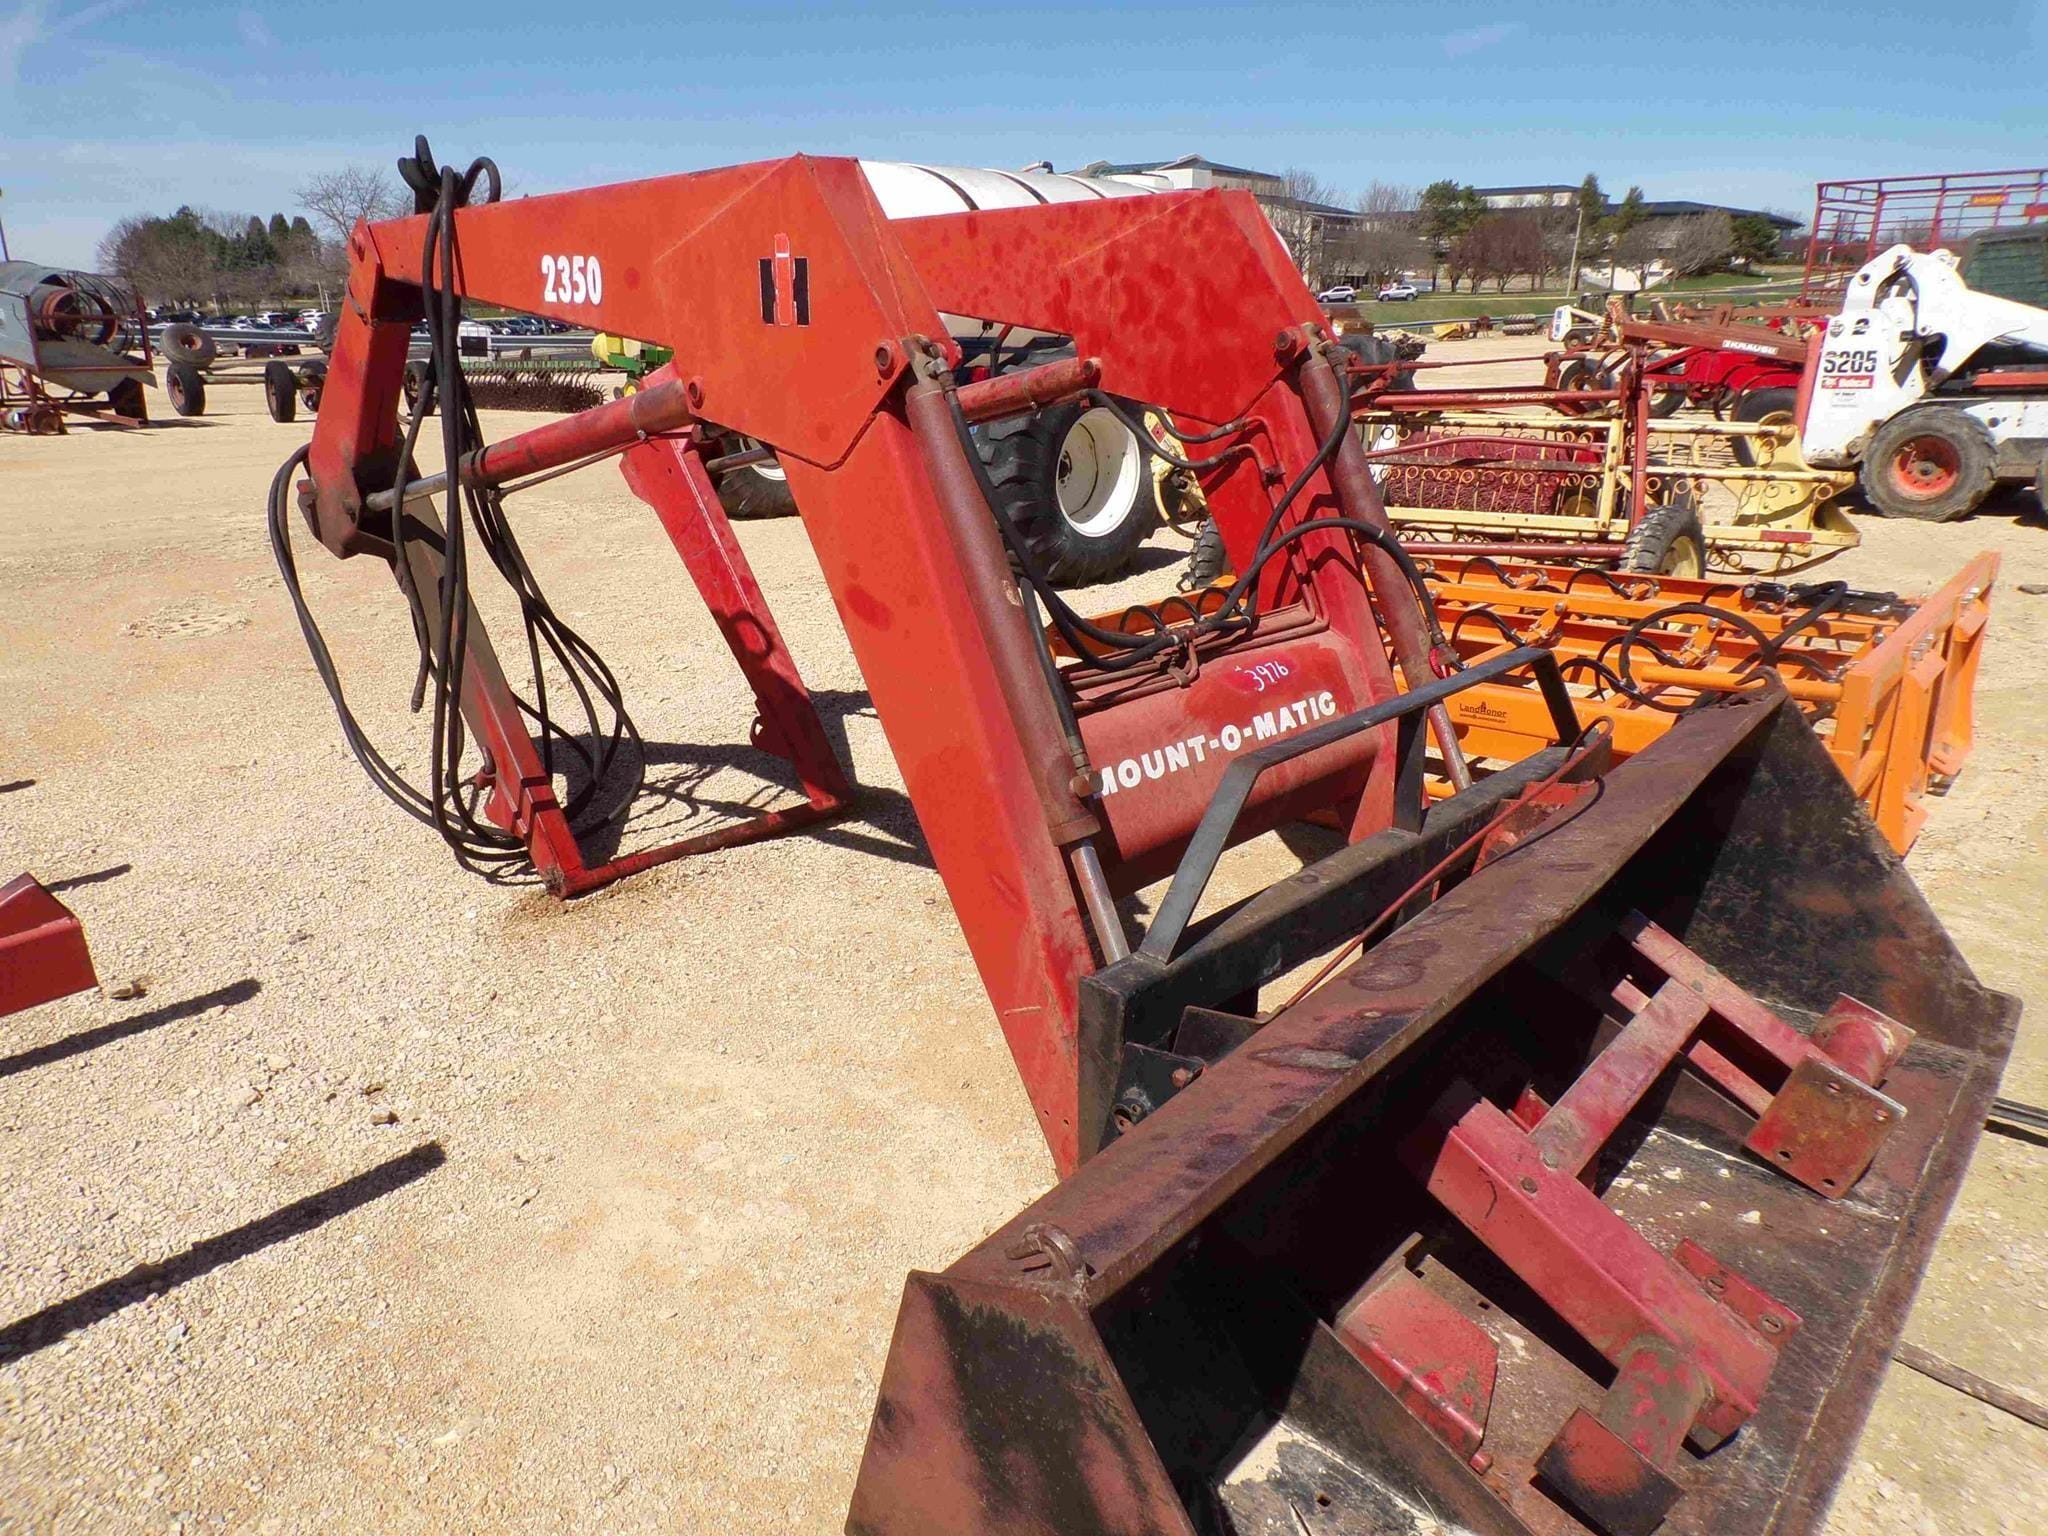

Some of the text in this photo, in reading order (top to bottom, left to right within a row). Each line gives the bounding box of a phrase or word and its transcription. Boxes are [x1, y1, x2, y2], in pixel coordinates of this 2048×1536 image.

[541, 254, 603, 306] 2350
[1852, 318, 1871, 336] 2
[1823, 350, 1878, 373] S205
[1243, 660, 1289, 692] 3976
